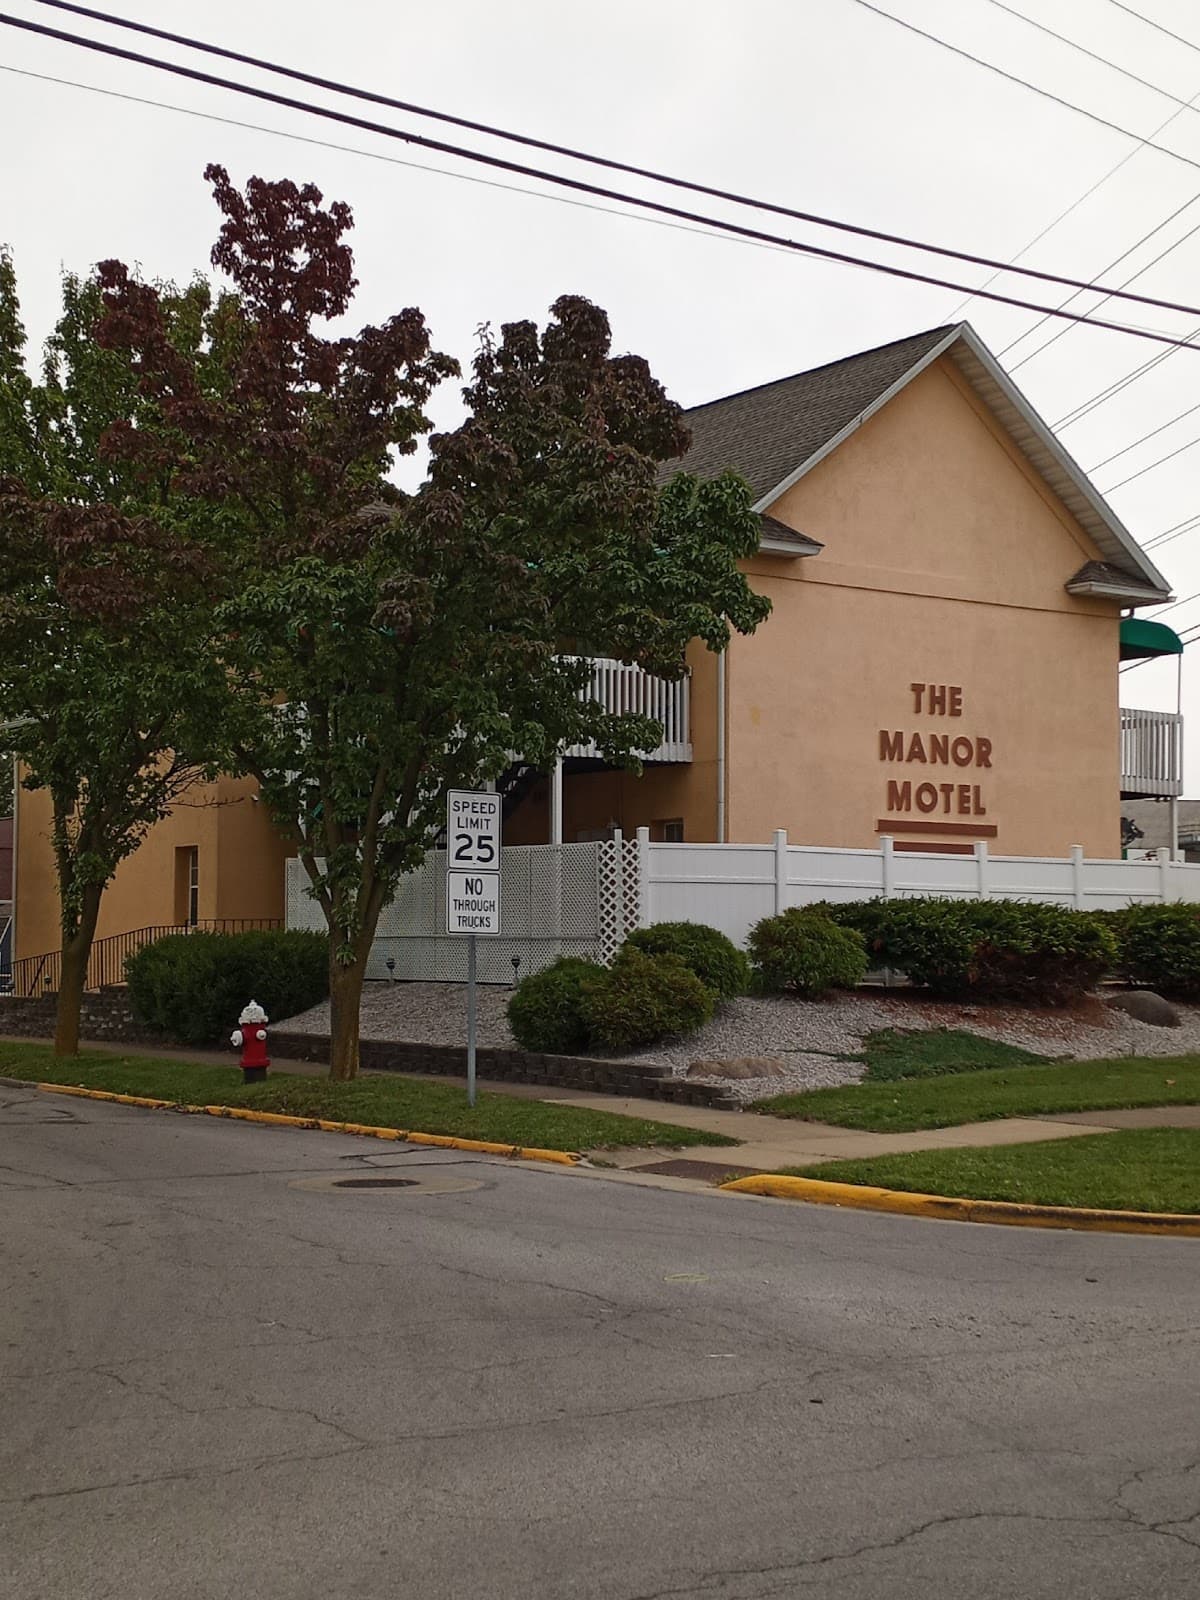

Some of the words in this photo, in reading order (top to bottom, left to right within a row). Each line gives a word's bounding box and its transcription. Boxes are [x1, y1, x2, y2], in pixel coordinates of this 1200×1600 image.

[911, 683, 962, 717] THE
[879, 730, 992, 768] MANOR
[887, 780, 986, 815] MOTEL
[452, 800, 496, 815] SPEED
[457, 816, 491, 830] LIMIT
[455, 833, 495, 863] 25
[465, 878, 483, 895] NO
[453, 898, 495, 913] THROUGH
[457, 915, 491, 928] TRUCKS
